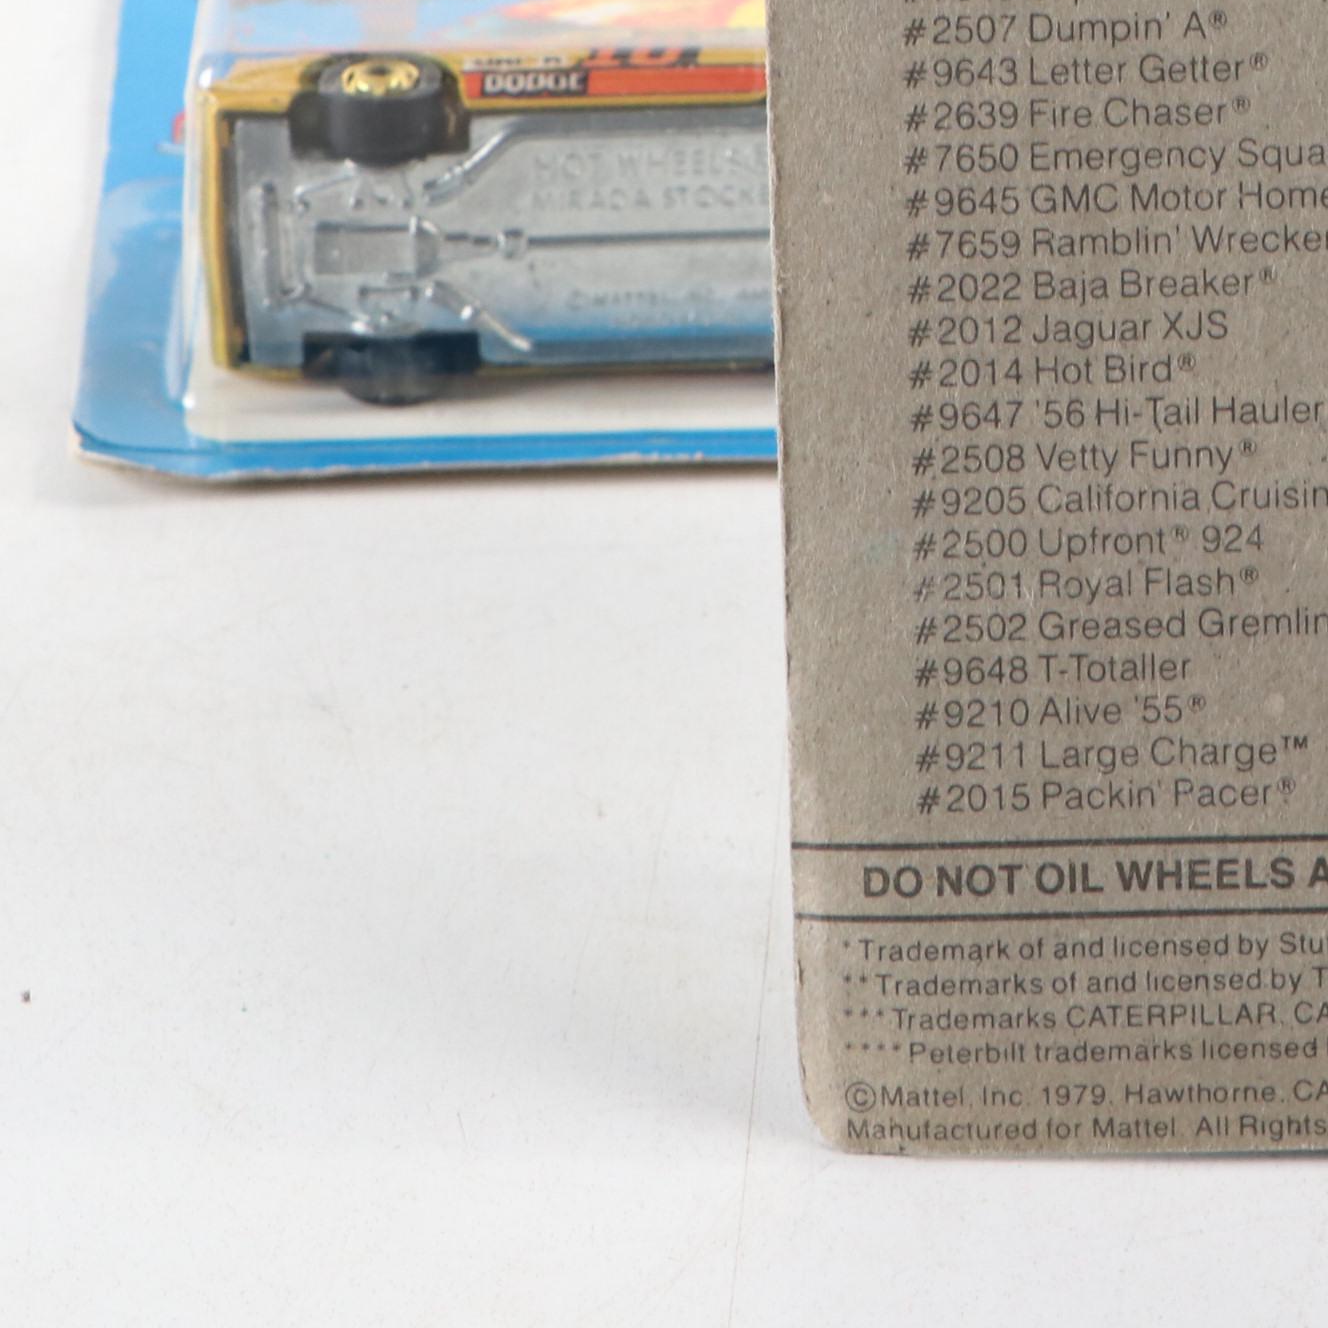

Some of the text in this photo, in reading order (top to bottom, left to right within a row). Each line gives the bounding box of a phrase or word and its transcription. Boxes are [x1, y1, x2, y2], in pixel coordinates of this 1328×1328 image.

[1030, 56, 1126, 85] Letter
[1030, 99, 1092, 128] Fire
[1030, 142, 1226, 177] Emergency
[1031, 183, 1118, 214] GMC
[1131, 183, 1226, 211] Motor
[1033, 315, 1151, 350] Jaguar
[1163, 310, 1228, 341] XJS
[1035, 356, 1091, 384] Hot
[1036, 443, 1118, 477] Vetty
[1038, 484, 1200, 514] California
[1202, 524, 1262, 553] 924
[1040, 569, 1131, 605] Royal
[1039, 609, 1185, 641] Greased
[1038, 653, 1190, 682] T-Totaller
[1040, 697, 1121, 725] Alive
[1041, 741, 1138, 775] Large
[864, 865, 923, 898] DO
[937, 864, 1023, 897] NOT
[1035, 861, 1104, 895] OIL
[1116, 856, 1295, 892] WHEELS
[1114, 935, 1229, 957] licensed
[1147, 969, 1261, 992] licensed
[1035, 1038, 1317, 1063] trademarks licensed
[843, 1118, 1037, 1148] Manufactured
[1239, 1115, 1327, 1142] Rights
